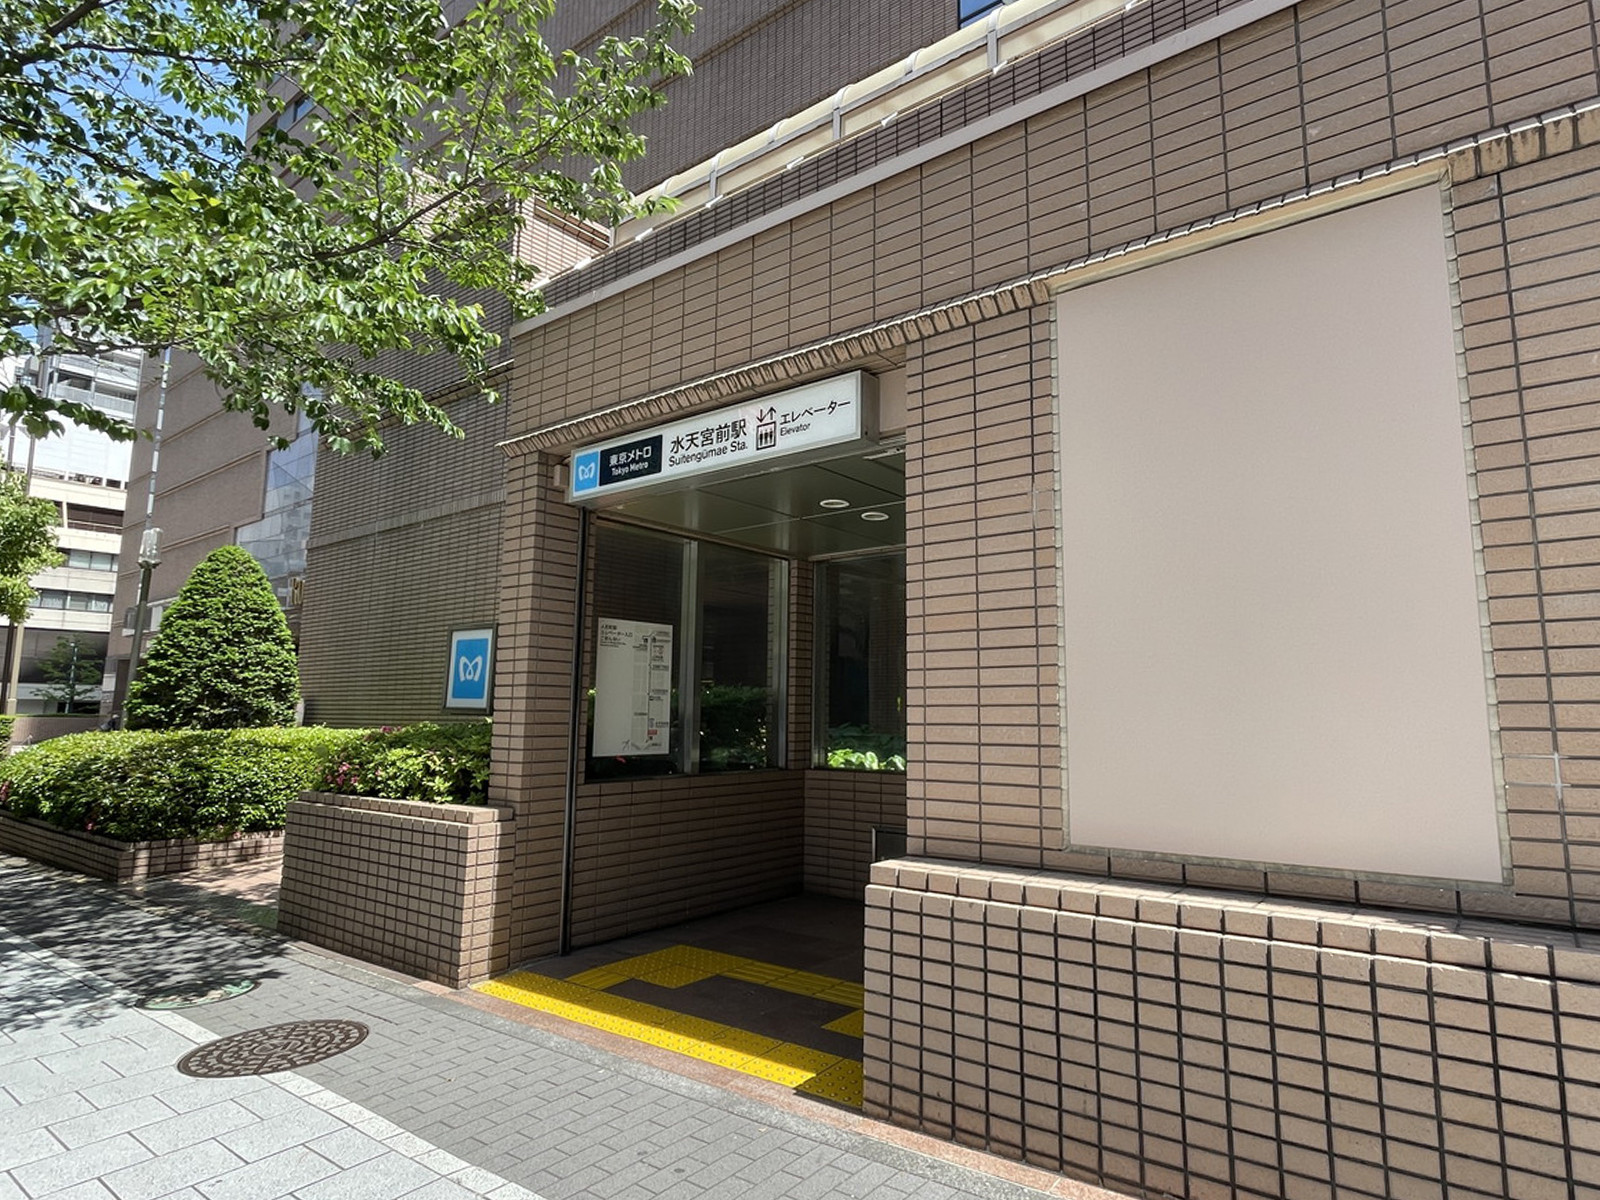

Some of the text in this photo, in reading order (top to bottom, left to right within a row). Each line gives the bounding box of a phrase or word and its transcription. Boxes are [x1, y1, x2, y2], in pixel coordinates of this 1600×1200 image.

[780, 401, 851, 425] エレベーター
[670, 418, 747, 454] 水天宮前駅
[780, 423, 811, 436] Elevator
[730, 440, 748, 453] Sta.
[609, 446, 652, 467] 東京メトロ
[611, 461, 649, 476] Tokyo Metro
